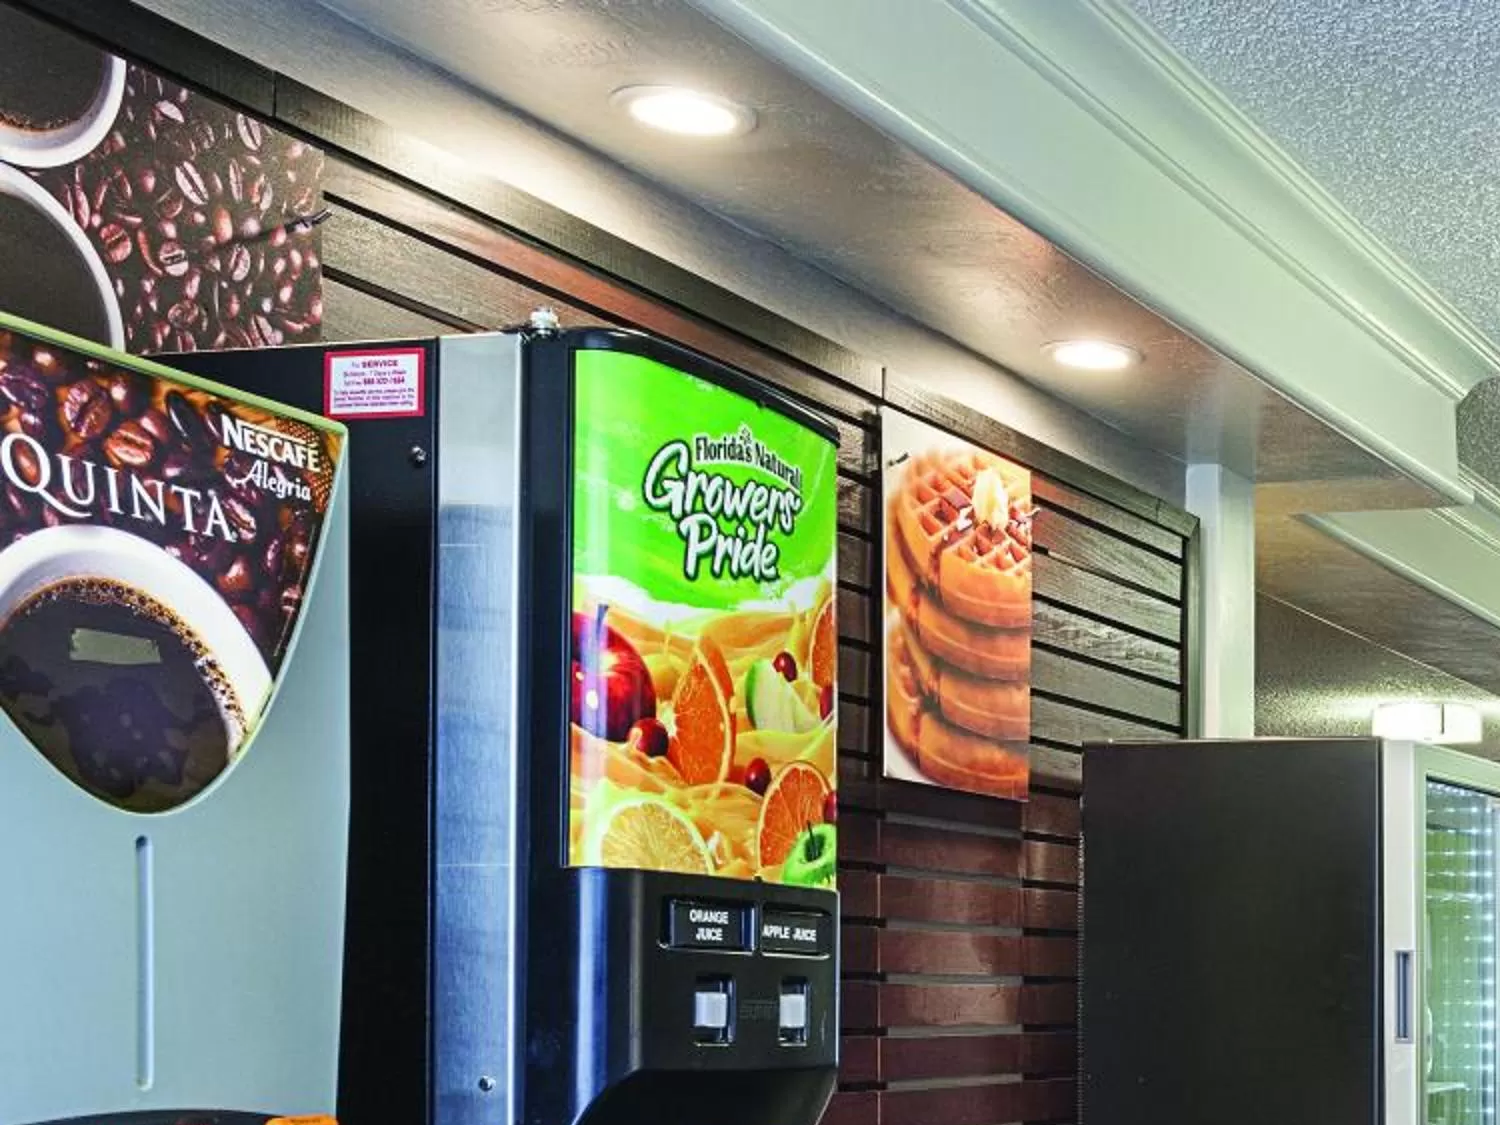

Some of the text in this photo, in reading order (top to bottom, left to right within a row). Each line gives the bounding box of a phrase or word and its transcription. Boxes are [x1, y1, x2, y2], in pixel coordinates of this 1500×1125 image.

[361, 359, 398, 368] SERVICE
[756, 442, 801, 486] Natural
[1, 432, 236, 543] QUINTA
[243, 460, 312, 501] Alegria
[678, 512, 780, 582] Pride
[688, 909, 729, 924] ORANGE
[696, 927, 723, 941] JUICE
[762, 925, 817, 942] APPLE JUICE
